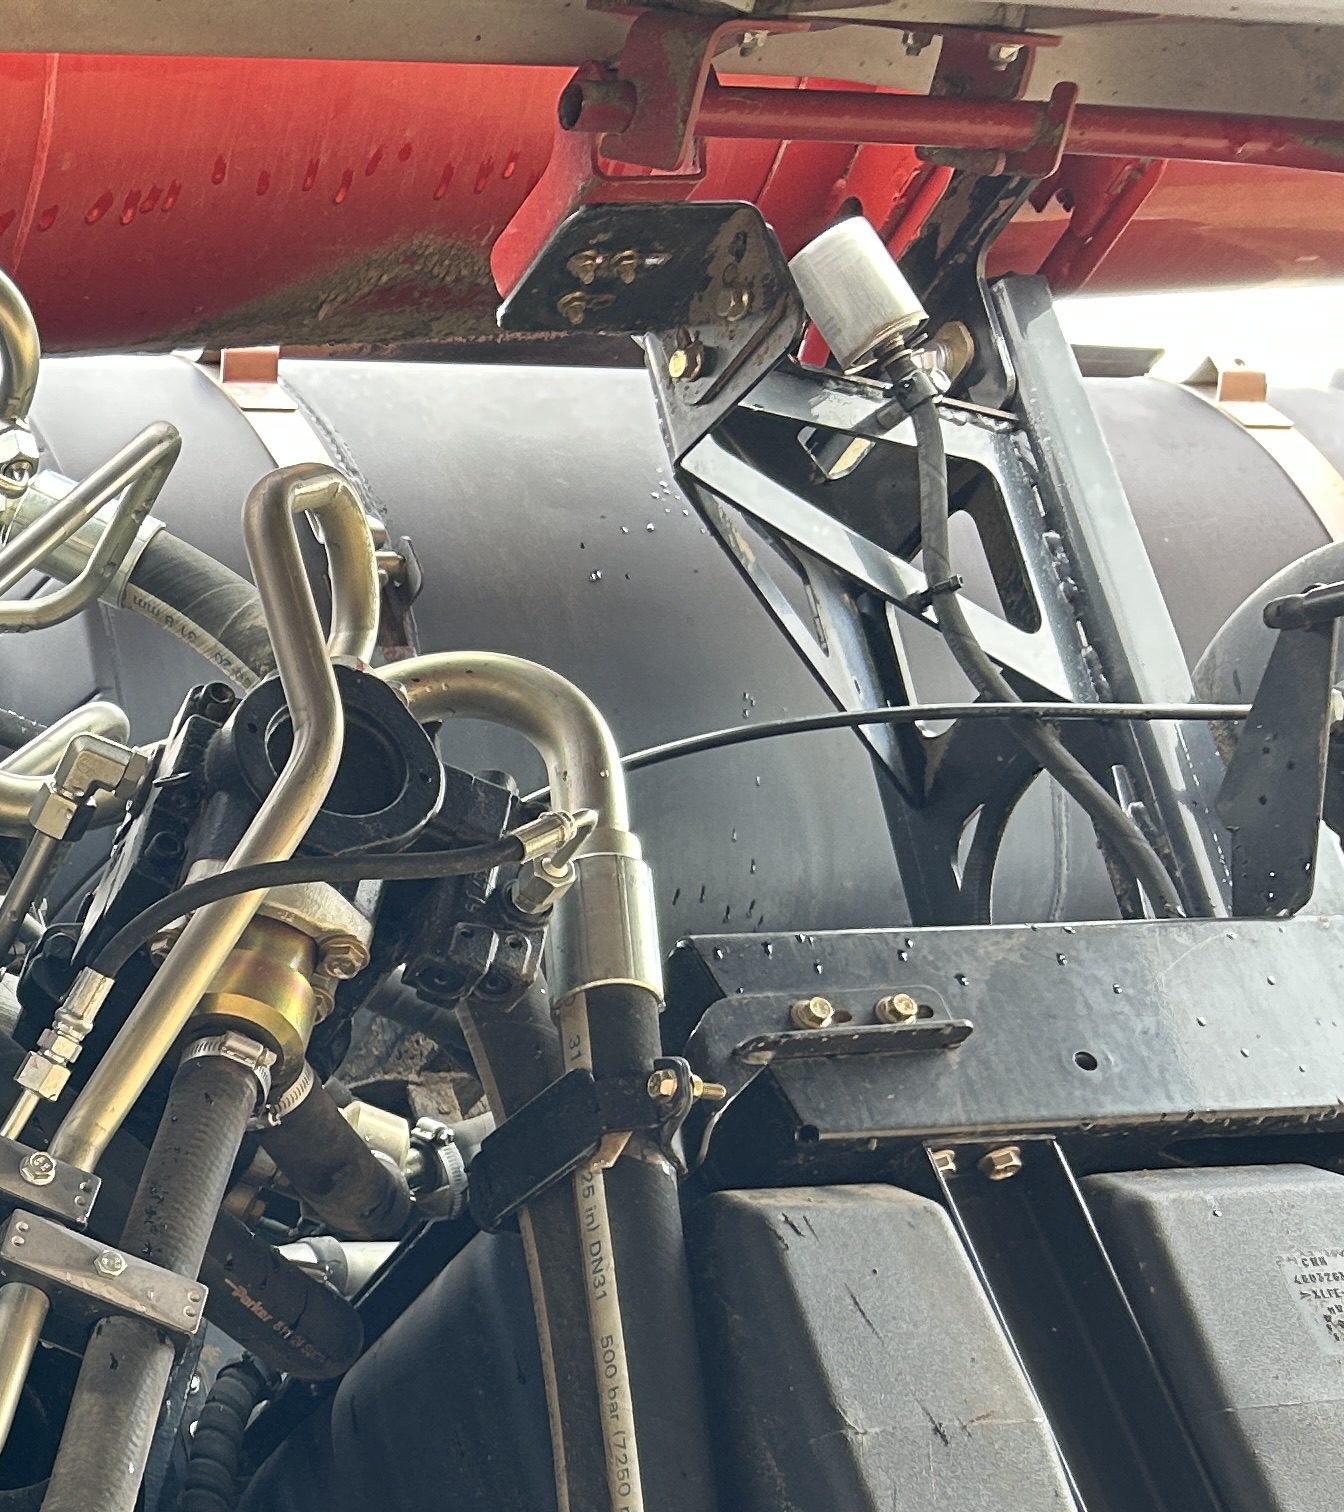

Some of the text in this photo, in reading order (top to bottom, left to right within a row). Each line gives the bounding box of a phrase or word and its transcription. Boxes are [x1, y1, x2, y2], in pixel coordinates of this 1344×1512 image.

[588, 1240, 607, 1303] DN31
[226, 1279, 273, 1322] Parker
[599, 1334, 618, 1381] 500
[606, 1385, 621, 1423] bar
[612, 1429, 632, 1498] (7250
